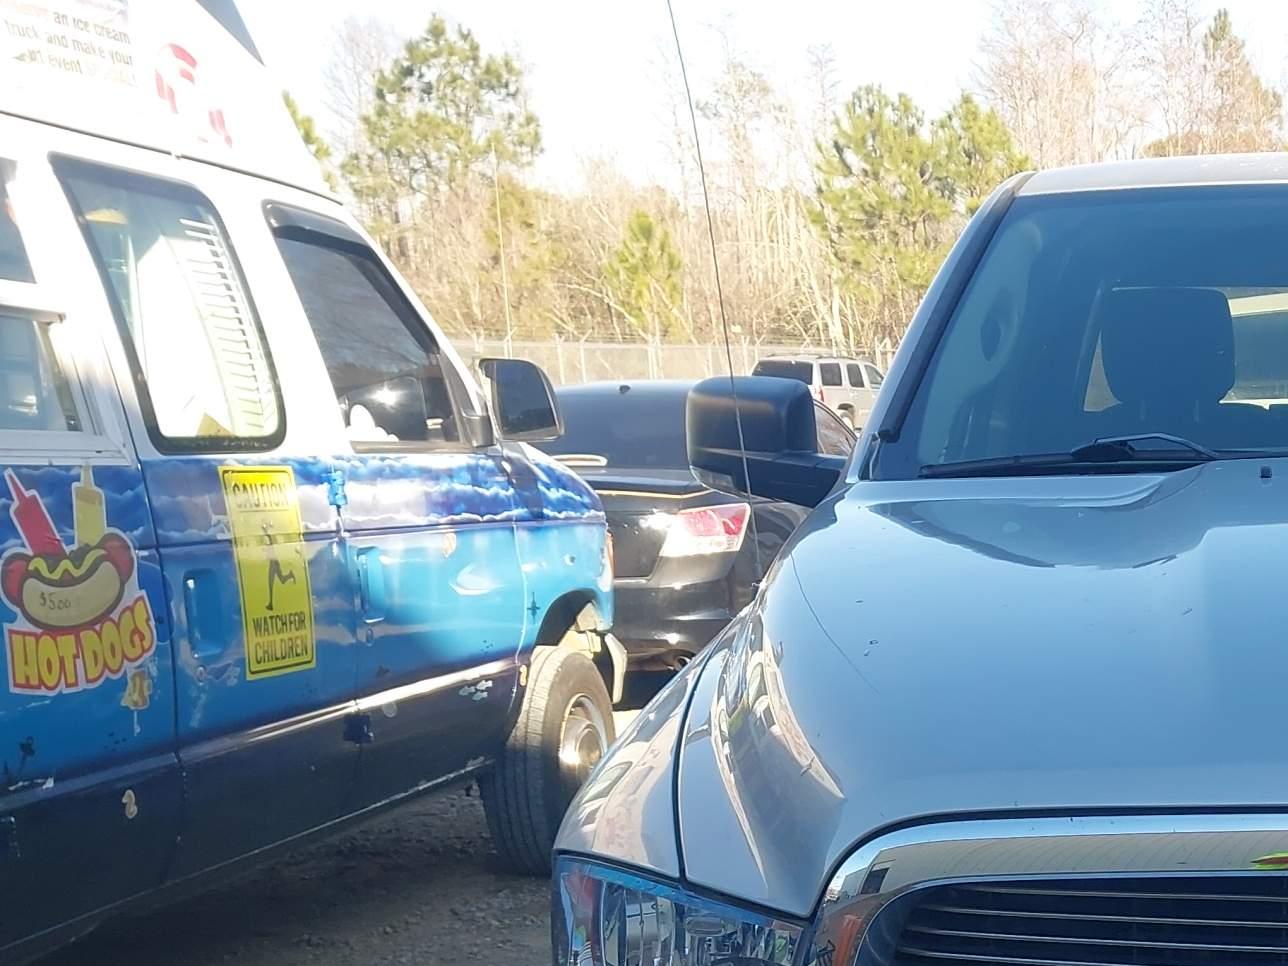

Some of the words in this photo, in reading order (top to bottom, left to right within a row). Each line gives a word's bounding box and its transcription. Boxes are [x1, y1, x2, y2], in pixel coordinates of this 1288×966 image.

[53, 11, 69, 26] an
[72, 17, 91, 33] ice
[94, 23, 131, 45] cream
[47, 33, 69, 49] and
[71, 39, 105, 59] make
[48, 53, 83, 74] event
[233, 483, 288, 508] CAUTION
[252, 614, 287, 637] WATCH
[288, 611, 306, 632] FOR
[10, 630, 79, 690] HOT
[80, 596, 153, 683] DOGS
[255, 634, 308, 664] CHILDREN
